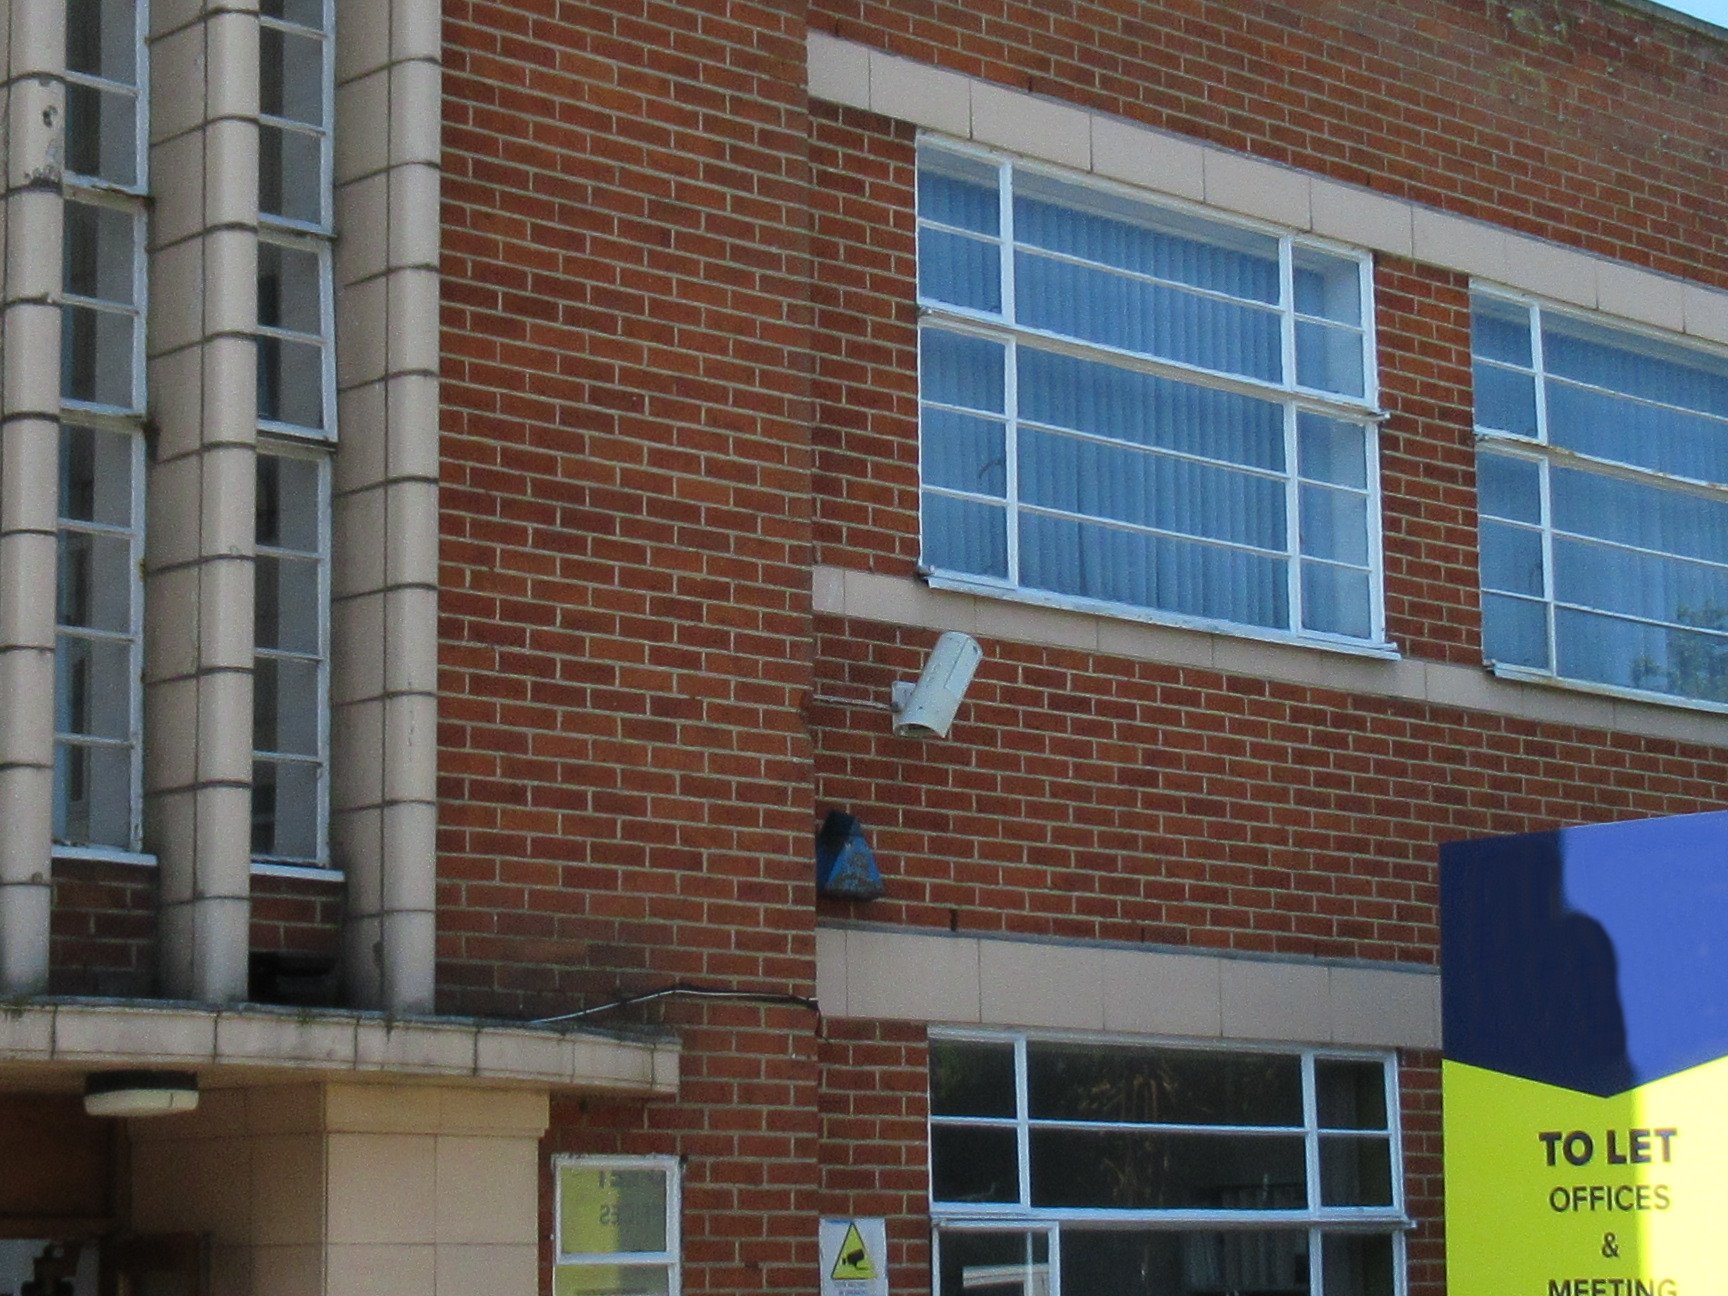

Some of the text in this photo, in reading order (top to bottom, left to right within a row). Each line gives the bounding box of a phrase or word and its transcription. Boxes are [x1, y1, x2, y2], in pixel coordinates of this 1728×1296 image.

[1538, 1127, 1677, 1166] TO LET
[1549, 1184, 1671, 1212] OFFICES
[1601, 1231, 1620, 1258] &
